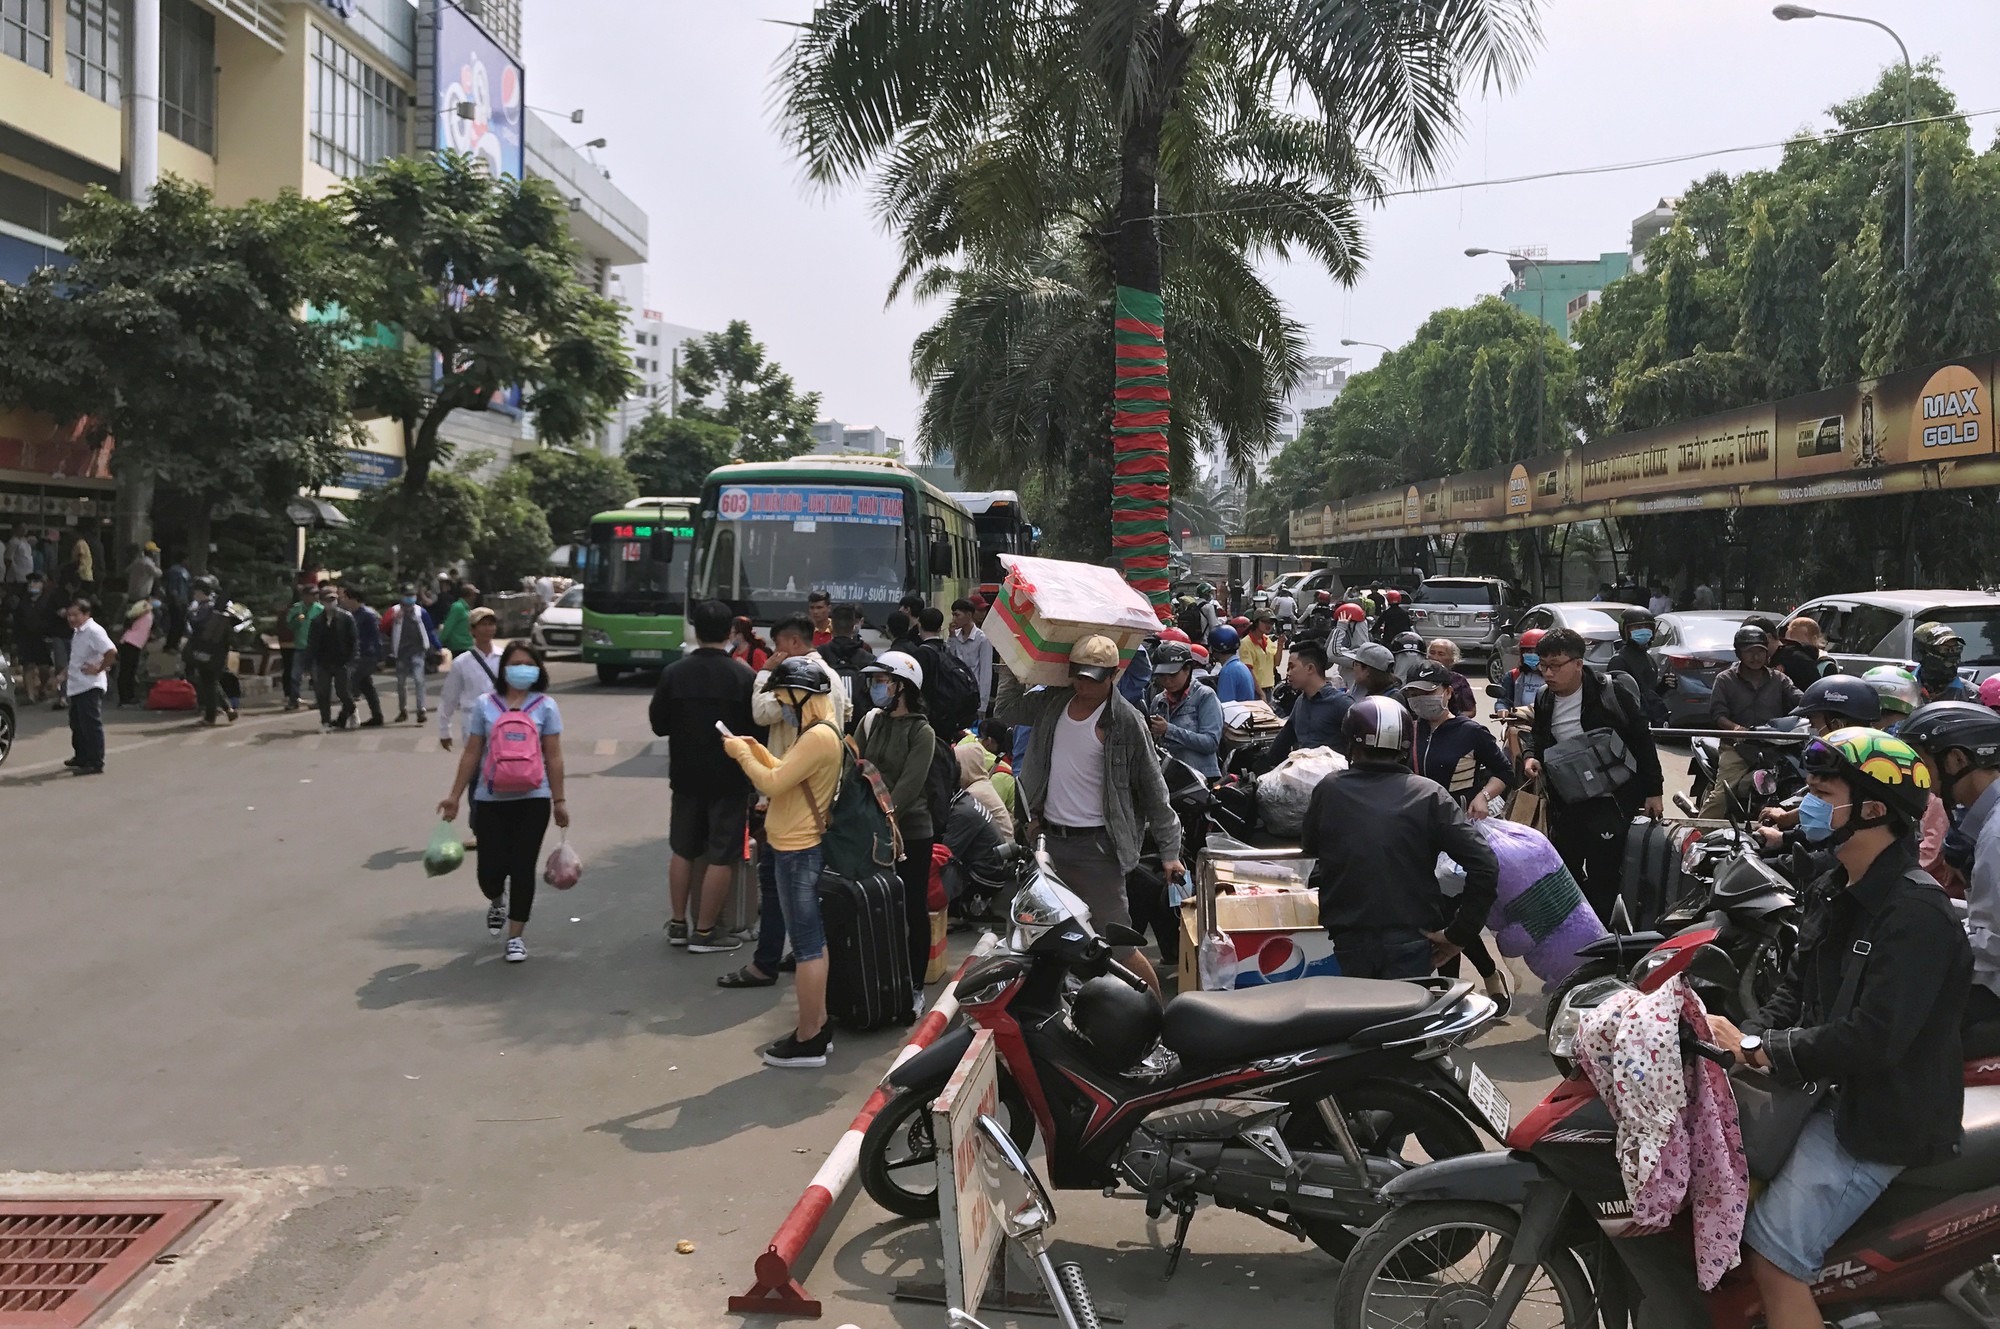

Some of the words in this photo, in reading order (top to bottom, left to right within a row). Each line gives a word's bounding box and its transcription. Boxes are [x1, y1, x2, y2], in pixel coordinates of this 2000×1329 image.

[1923, 387, 1981, 420] MAX
[1923, 421, 1979, 448] GOLD
[1823, 484, 1837, 495] CHO
[1858, 477, 1883, 492] KHÁCH
[721, 494, 747, 513] 603
[848, 582, 864, 600] TÀU
[868, 584, 886, 601] SUỐI
